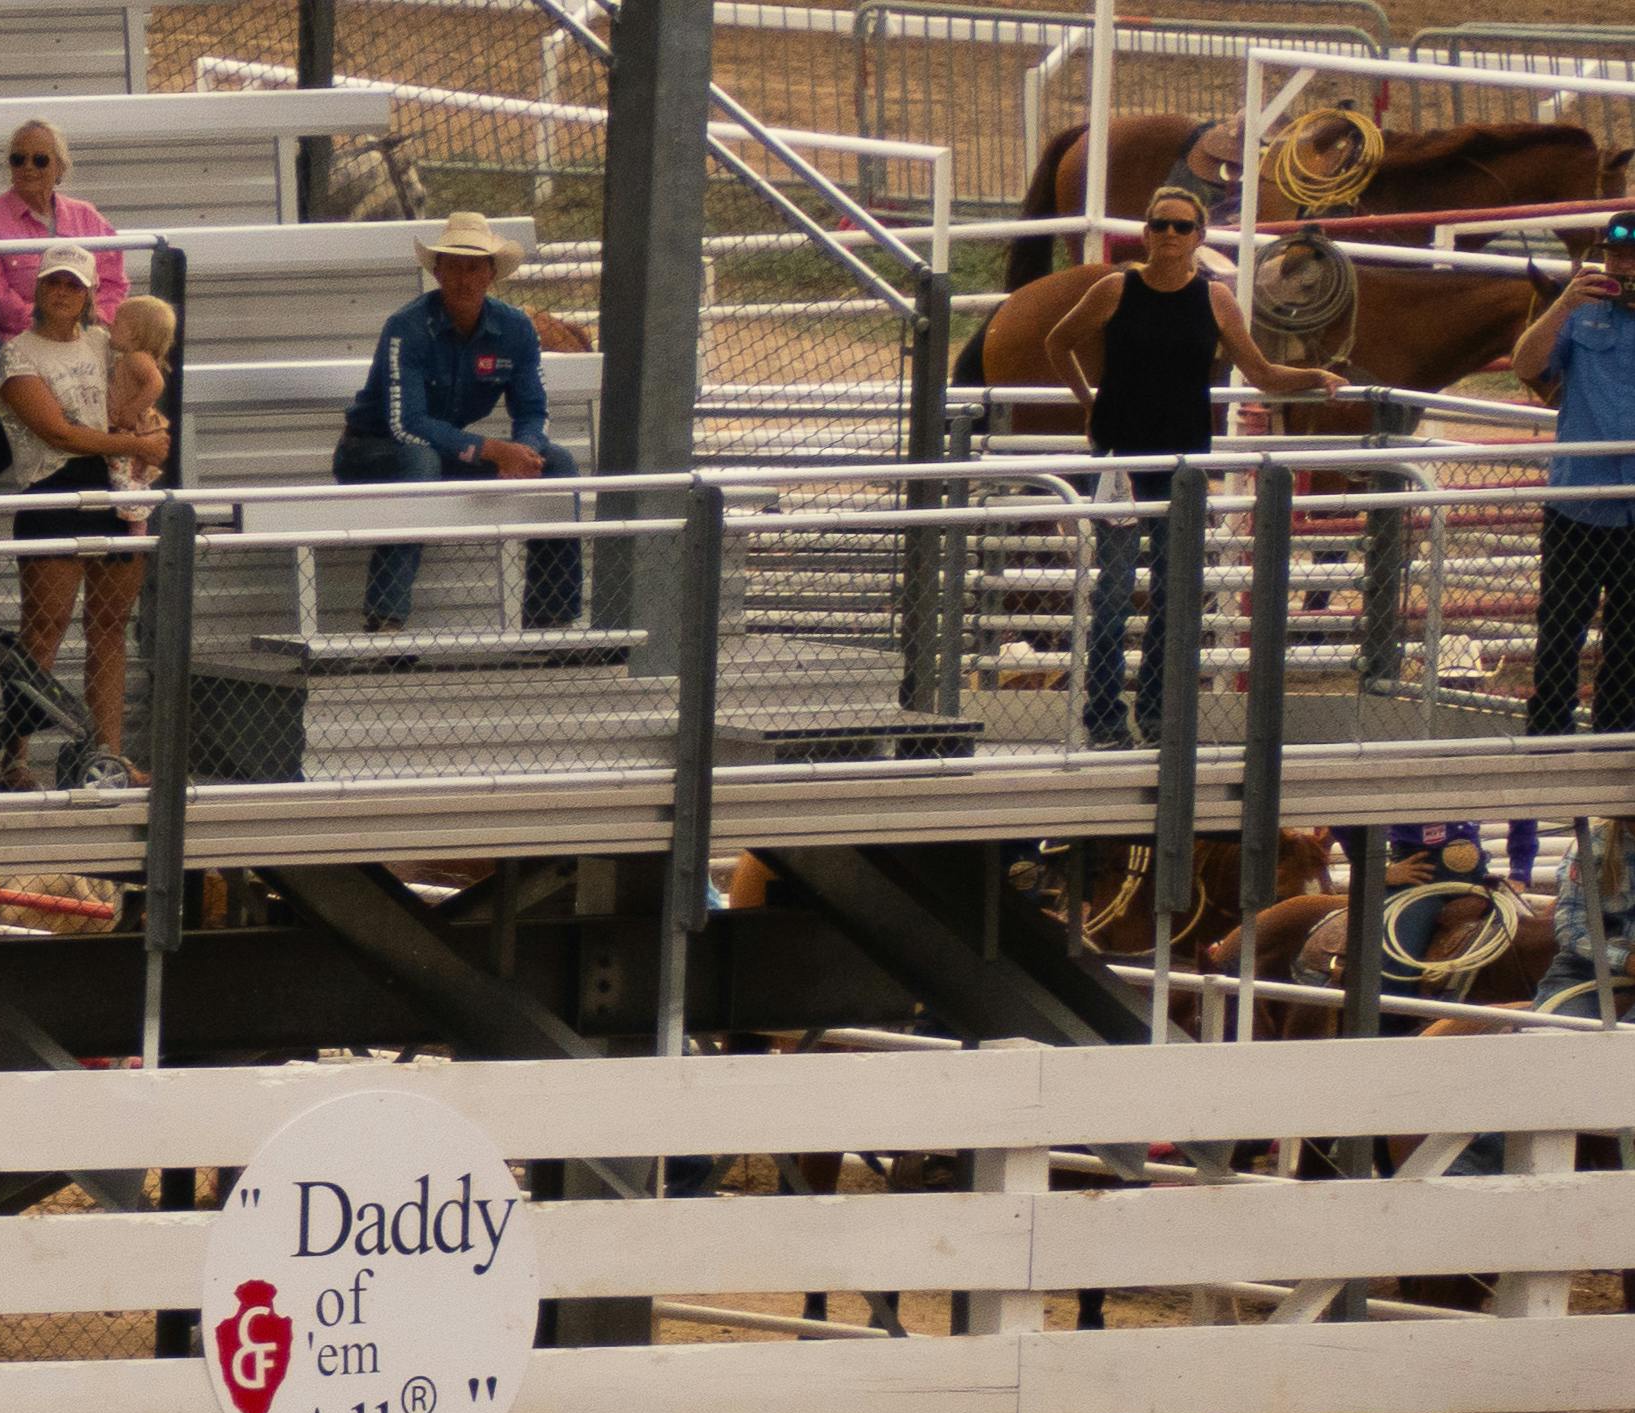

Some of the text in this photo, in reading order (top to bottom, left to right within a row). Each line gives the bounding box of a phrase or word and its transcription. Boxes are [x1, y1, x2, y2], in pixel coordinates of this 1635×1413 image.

[290, 1173, 517, 1276] Daddy
[316, 1268, 374, 1327] of
[307, 1331, 381, 1377] 'em
